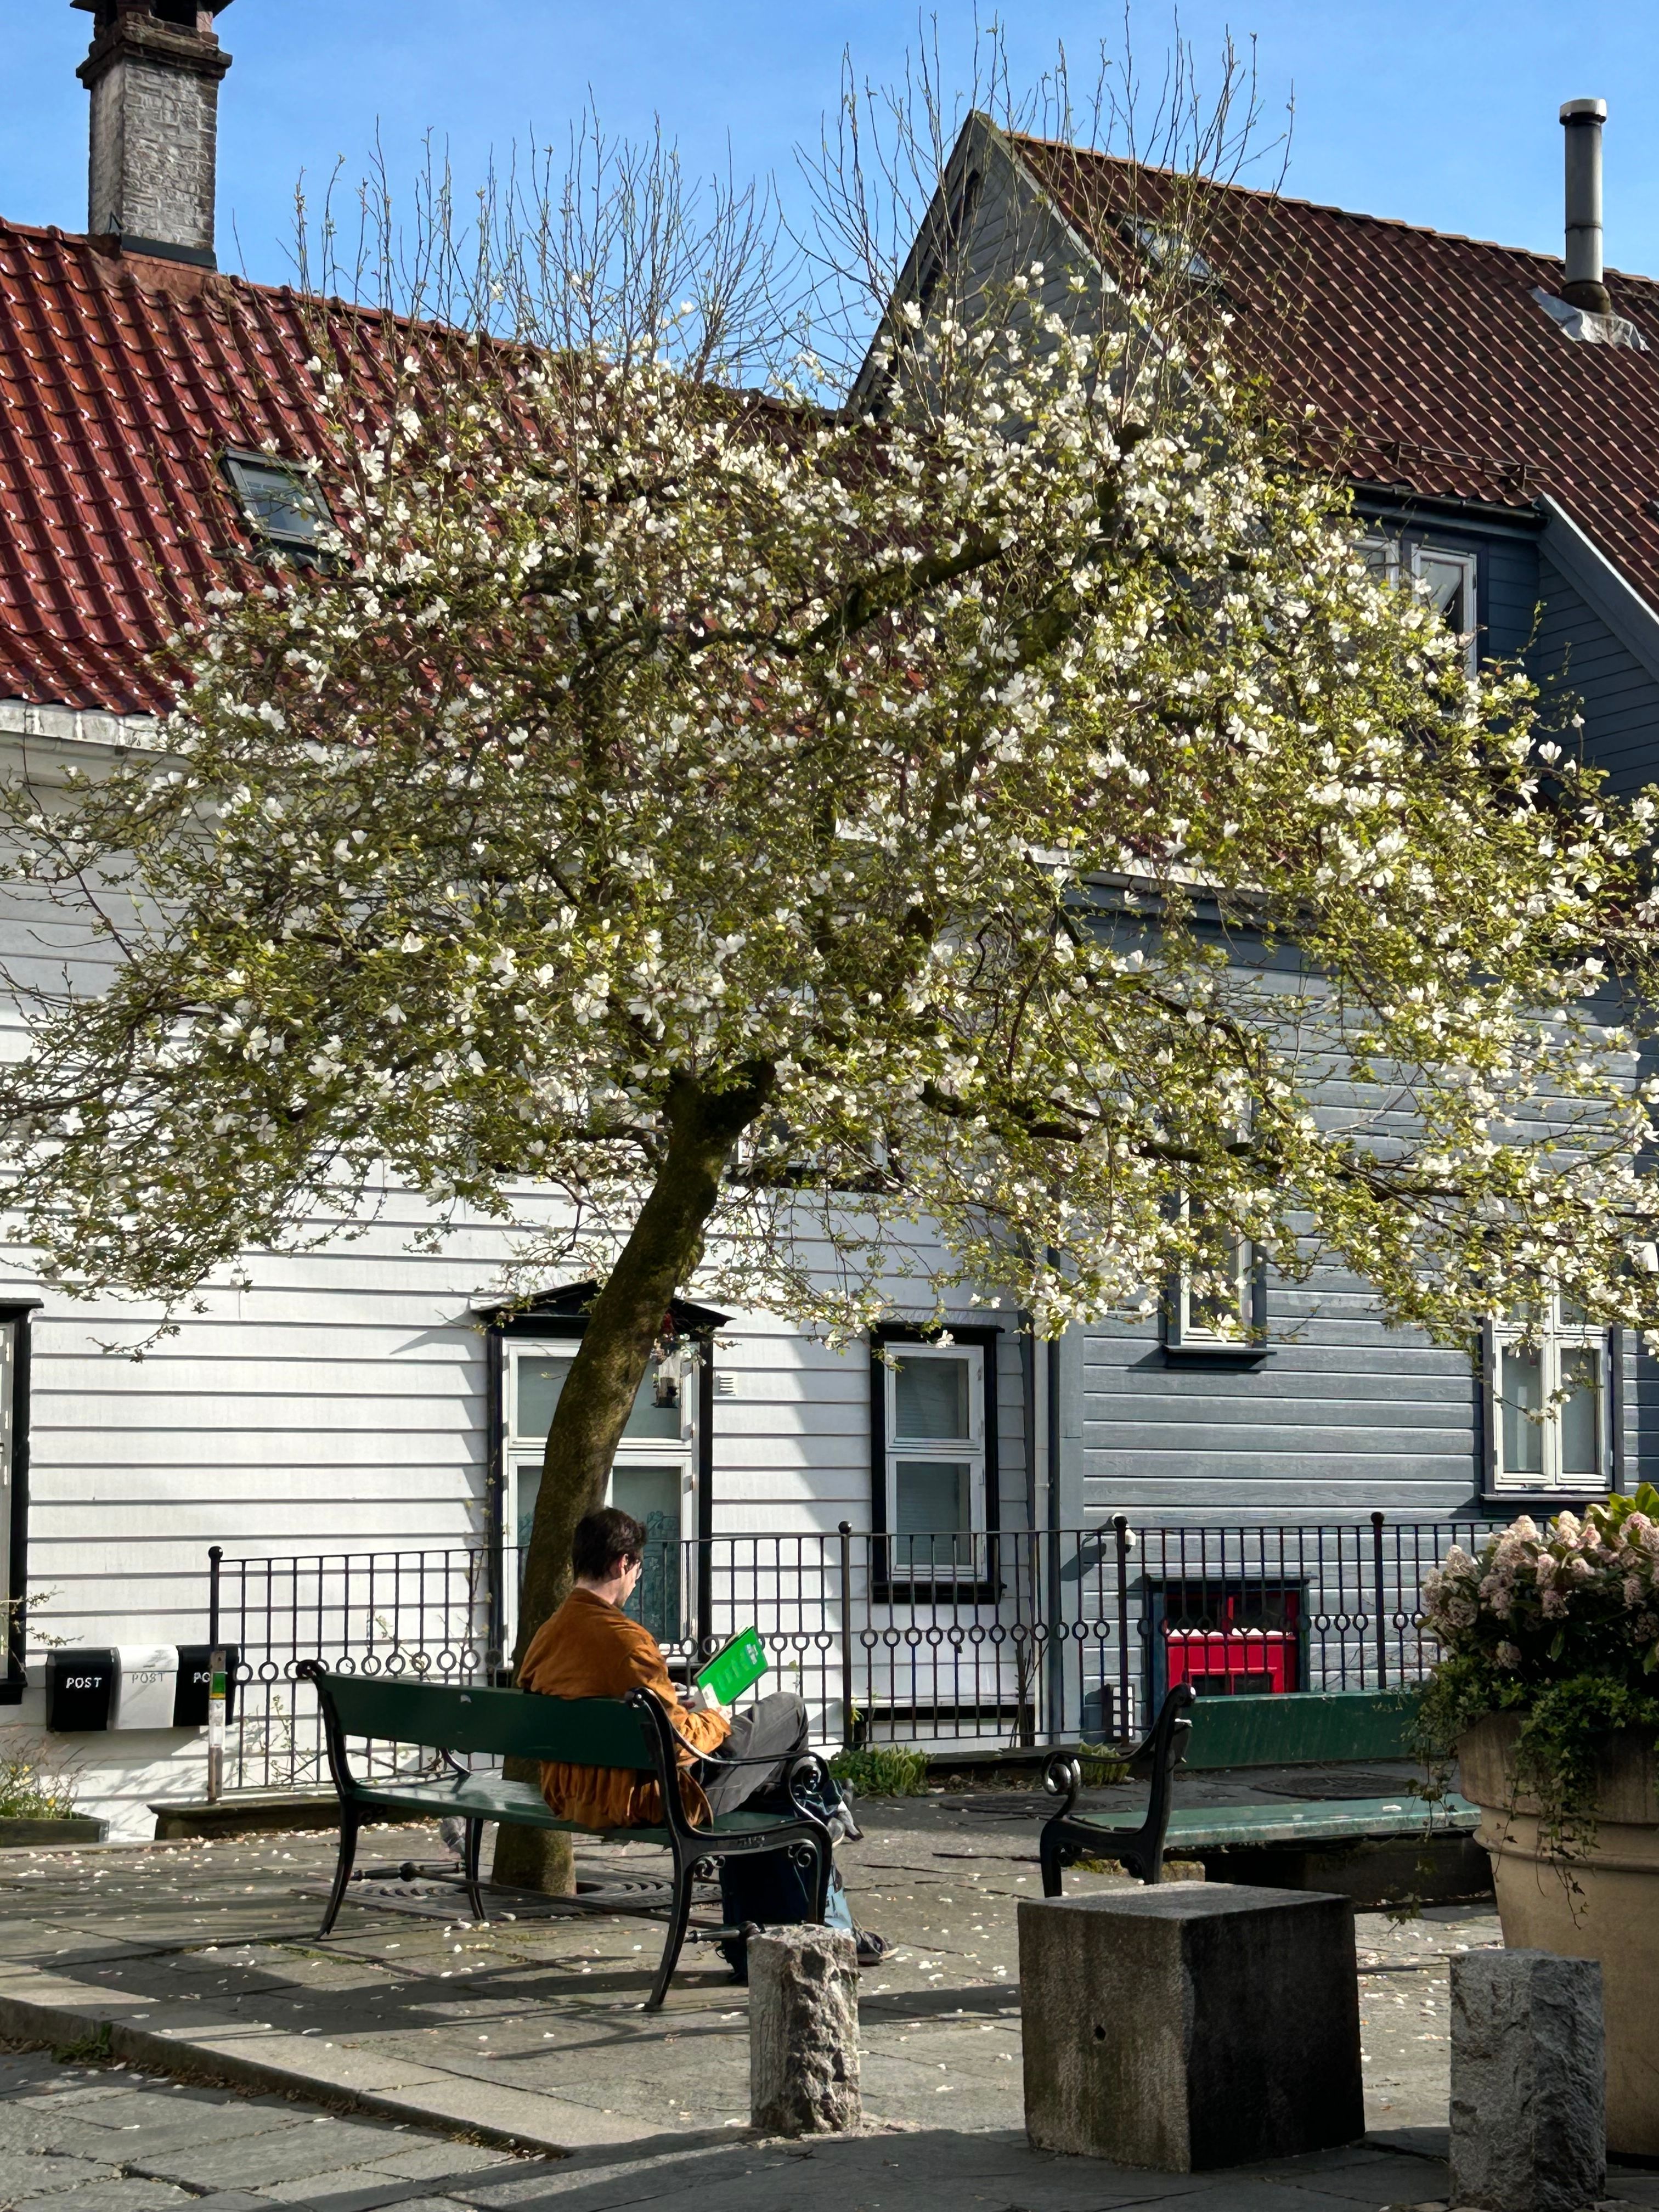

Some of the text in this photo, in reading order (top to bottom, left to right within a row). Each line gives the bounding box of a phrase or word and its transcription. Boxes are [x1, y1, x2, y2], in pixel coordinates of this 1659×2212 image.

[65, 1677, 102, 1688] POST
[132, 1673, 163, 1683] POST
[194, 1672, 211, 1683] PO
